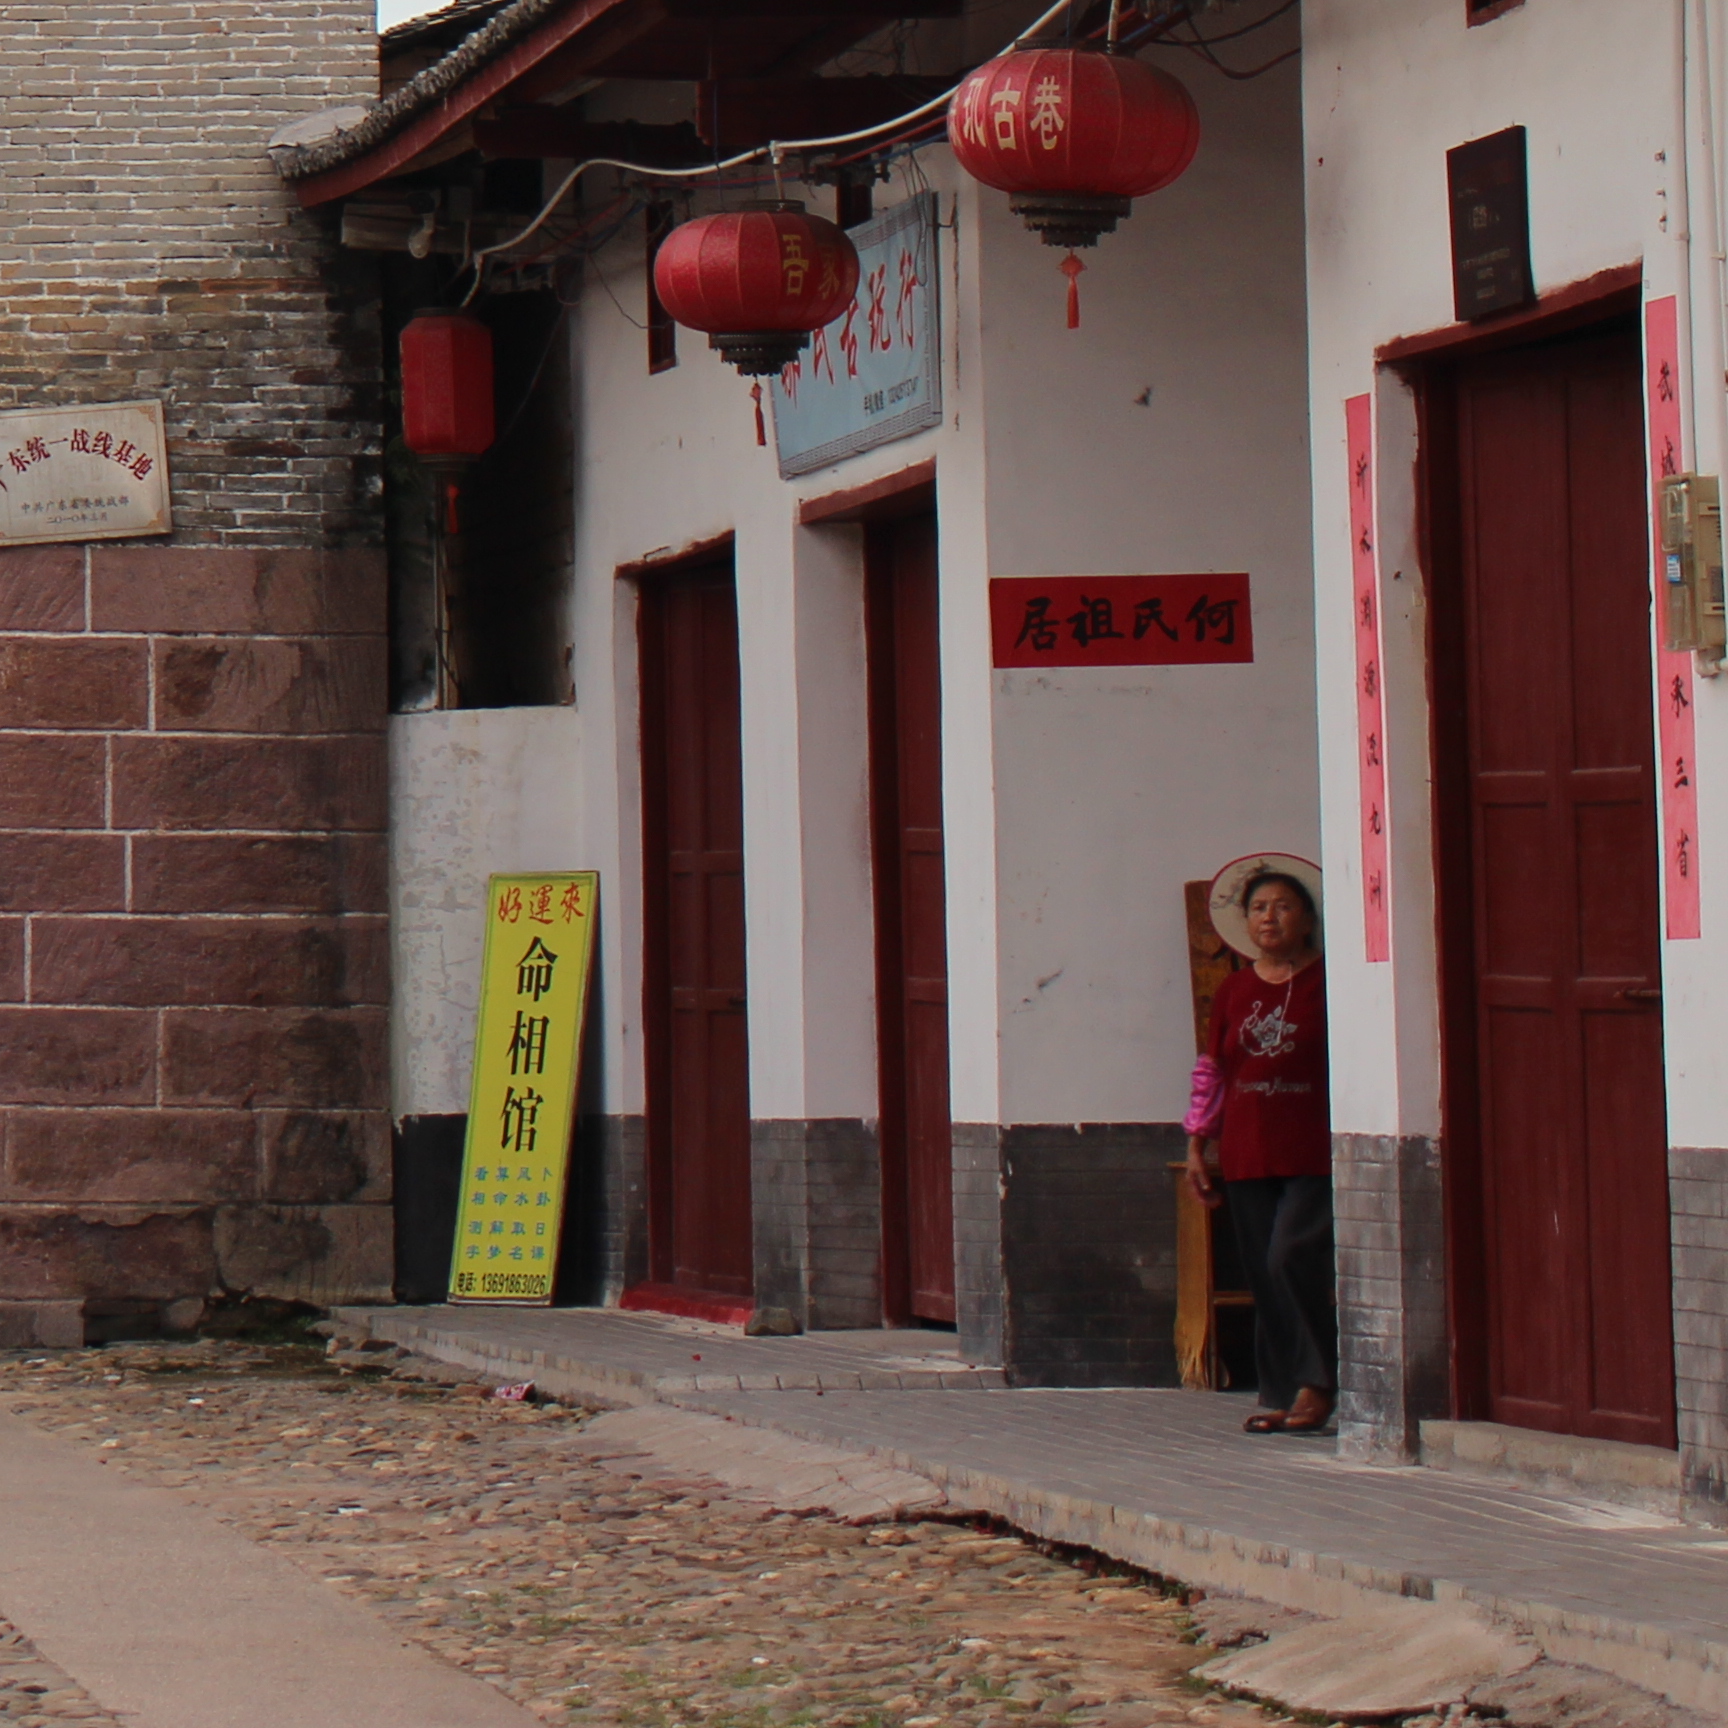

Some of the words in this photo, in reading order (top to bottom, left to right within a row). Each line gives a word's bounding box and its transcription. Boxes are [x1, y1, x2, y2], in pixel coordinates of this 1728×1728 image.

[781, 234, 856, 300] 吾家
[21, 495, 131, 514] 中共广东省委统战部
[498, 881, 585, 925] 好運來
[499, 935, 559, 1154] 命相馆
